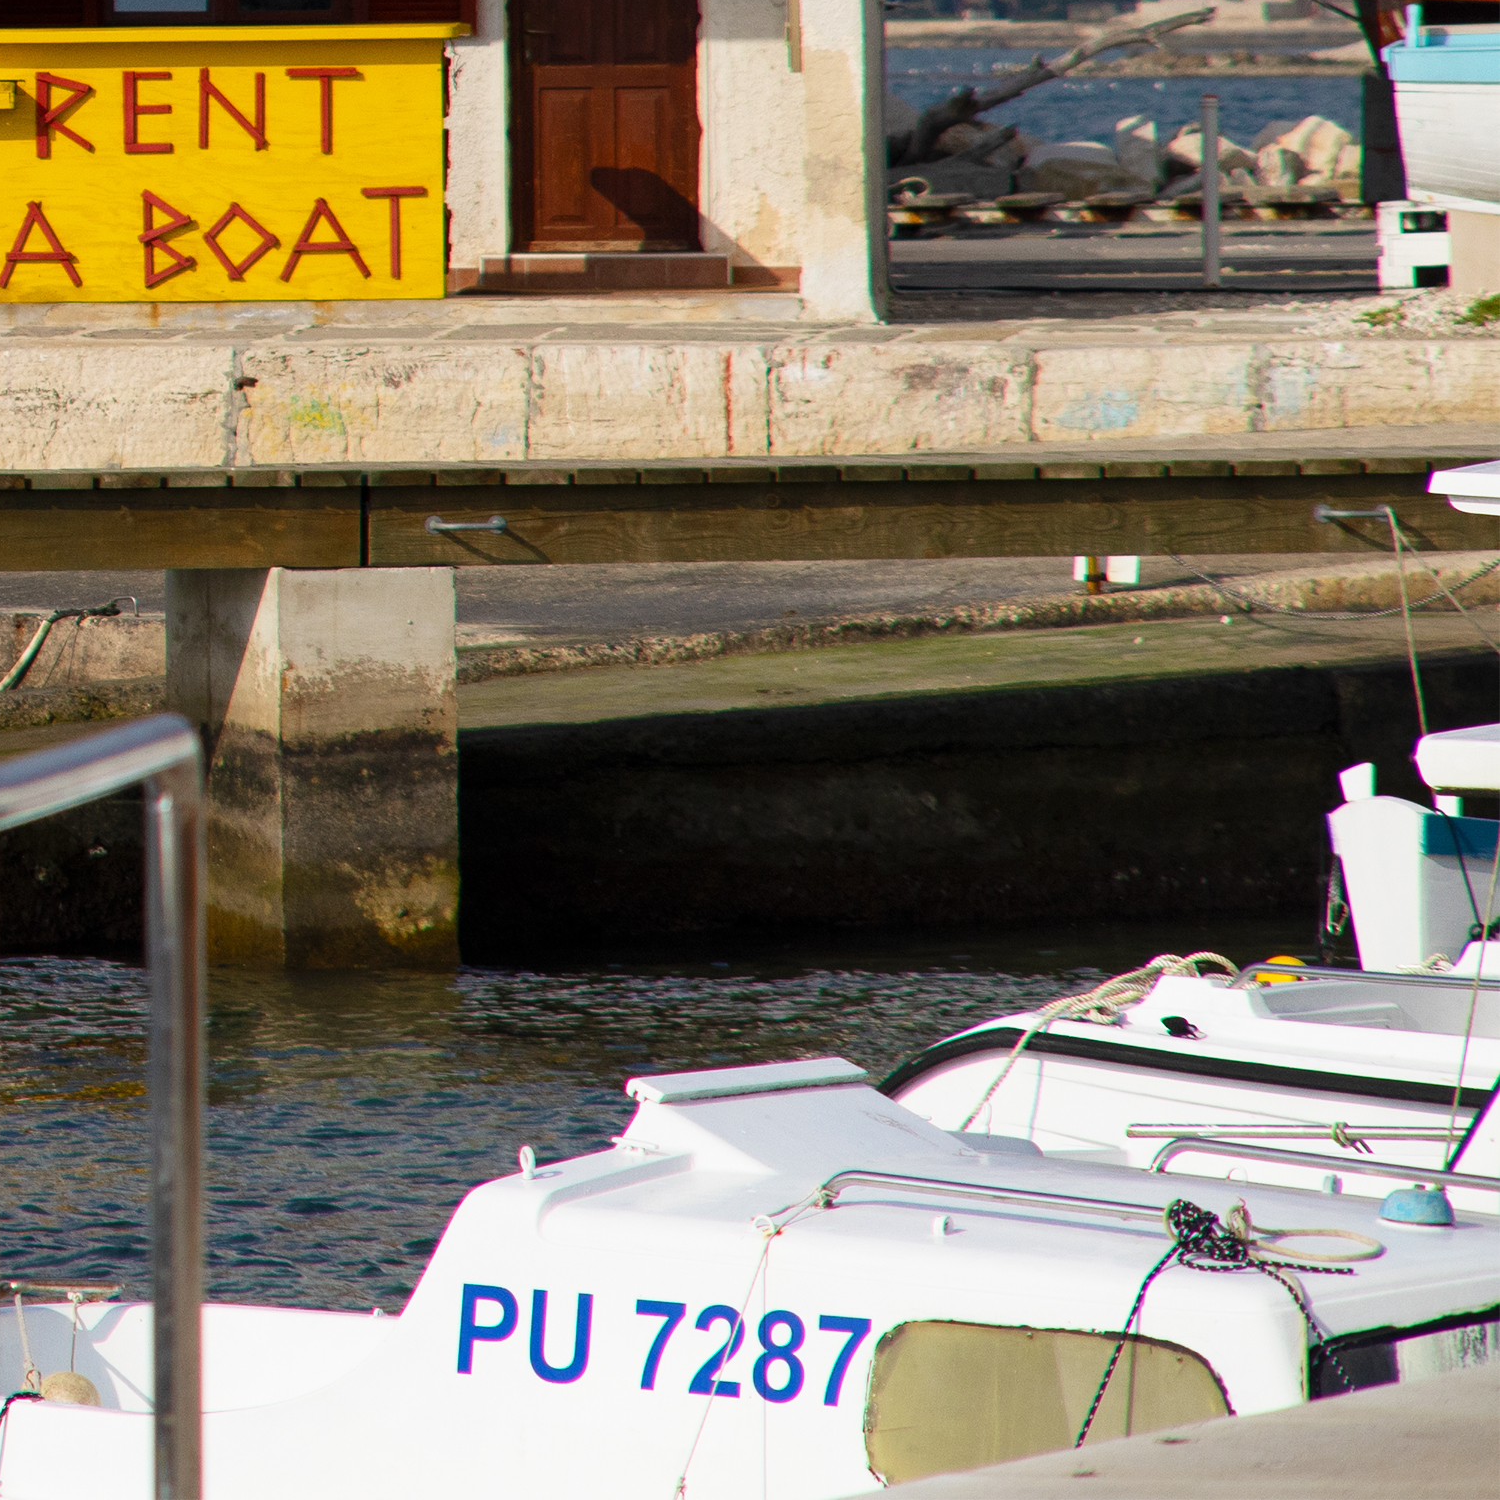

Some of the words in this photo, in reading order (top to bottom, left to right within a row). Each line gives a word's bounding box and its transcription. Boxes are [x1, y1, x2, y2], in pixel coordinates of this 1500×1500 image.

[35, 67, 359, 159] RENT
[138, 186, 428, 288] BOAT
[457, 1283, 593, 1385] PU
[635, 1299, 872, 1408] 7287
